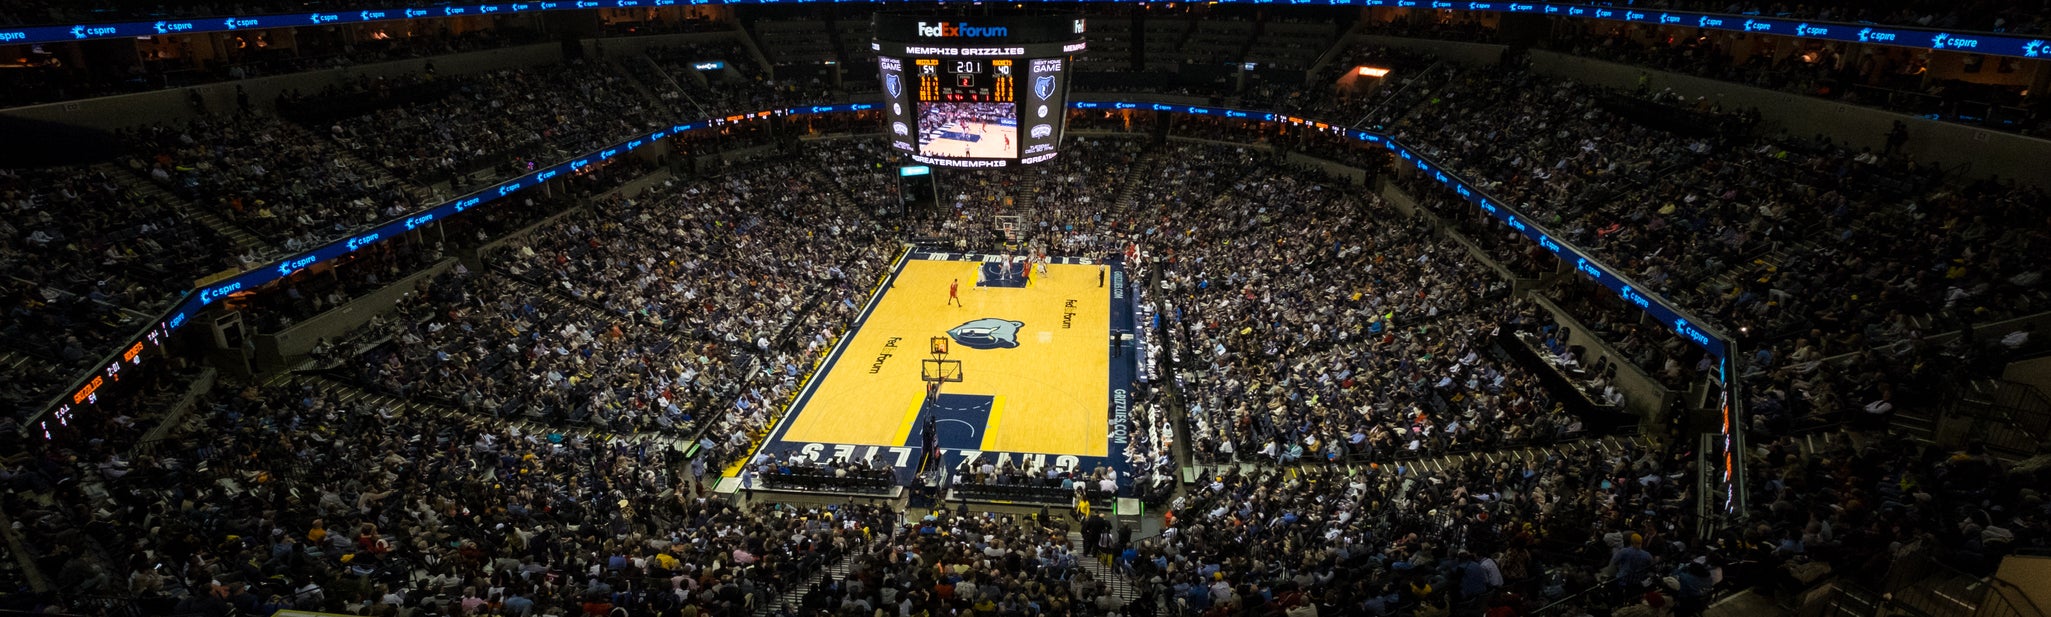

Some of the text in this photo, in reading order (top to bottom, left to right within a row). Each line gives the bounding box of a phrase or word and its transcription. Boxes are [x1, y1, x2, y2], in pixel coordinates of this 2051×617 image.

[918, 21, 1008, 38] FedExForum
[906, 46, 1025, 56] MEMPHIS GRIZZLIES
[882, 62, 902, 72] GAME
[923, 65, 934, 74] 54
[957, 62, 980, 73] 2:01
[998, 66, 1009, 74] 40
[1034, 64, 1061, 72] GAME
[106, 361, 120, 377] 2:01
[1114, 388, 1127, 444] GRIZZLIES.COM
